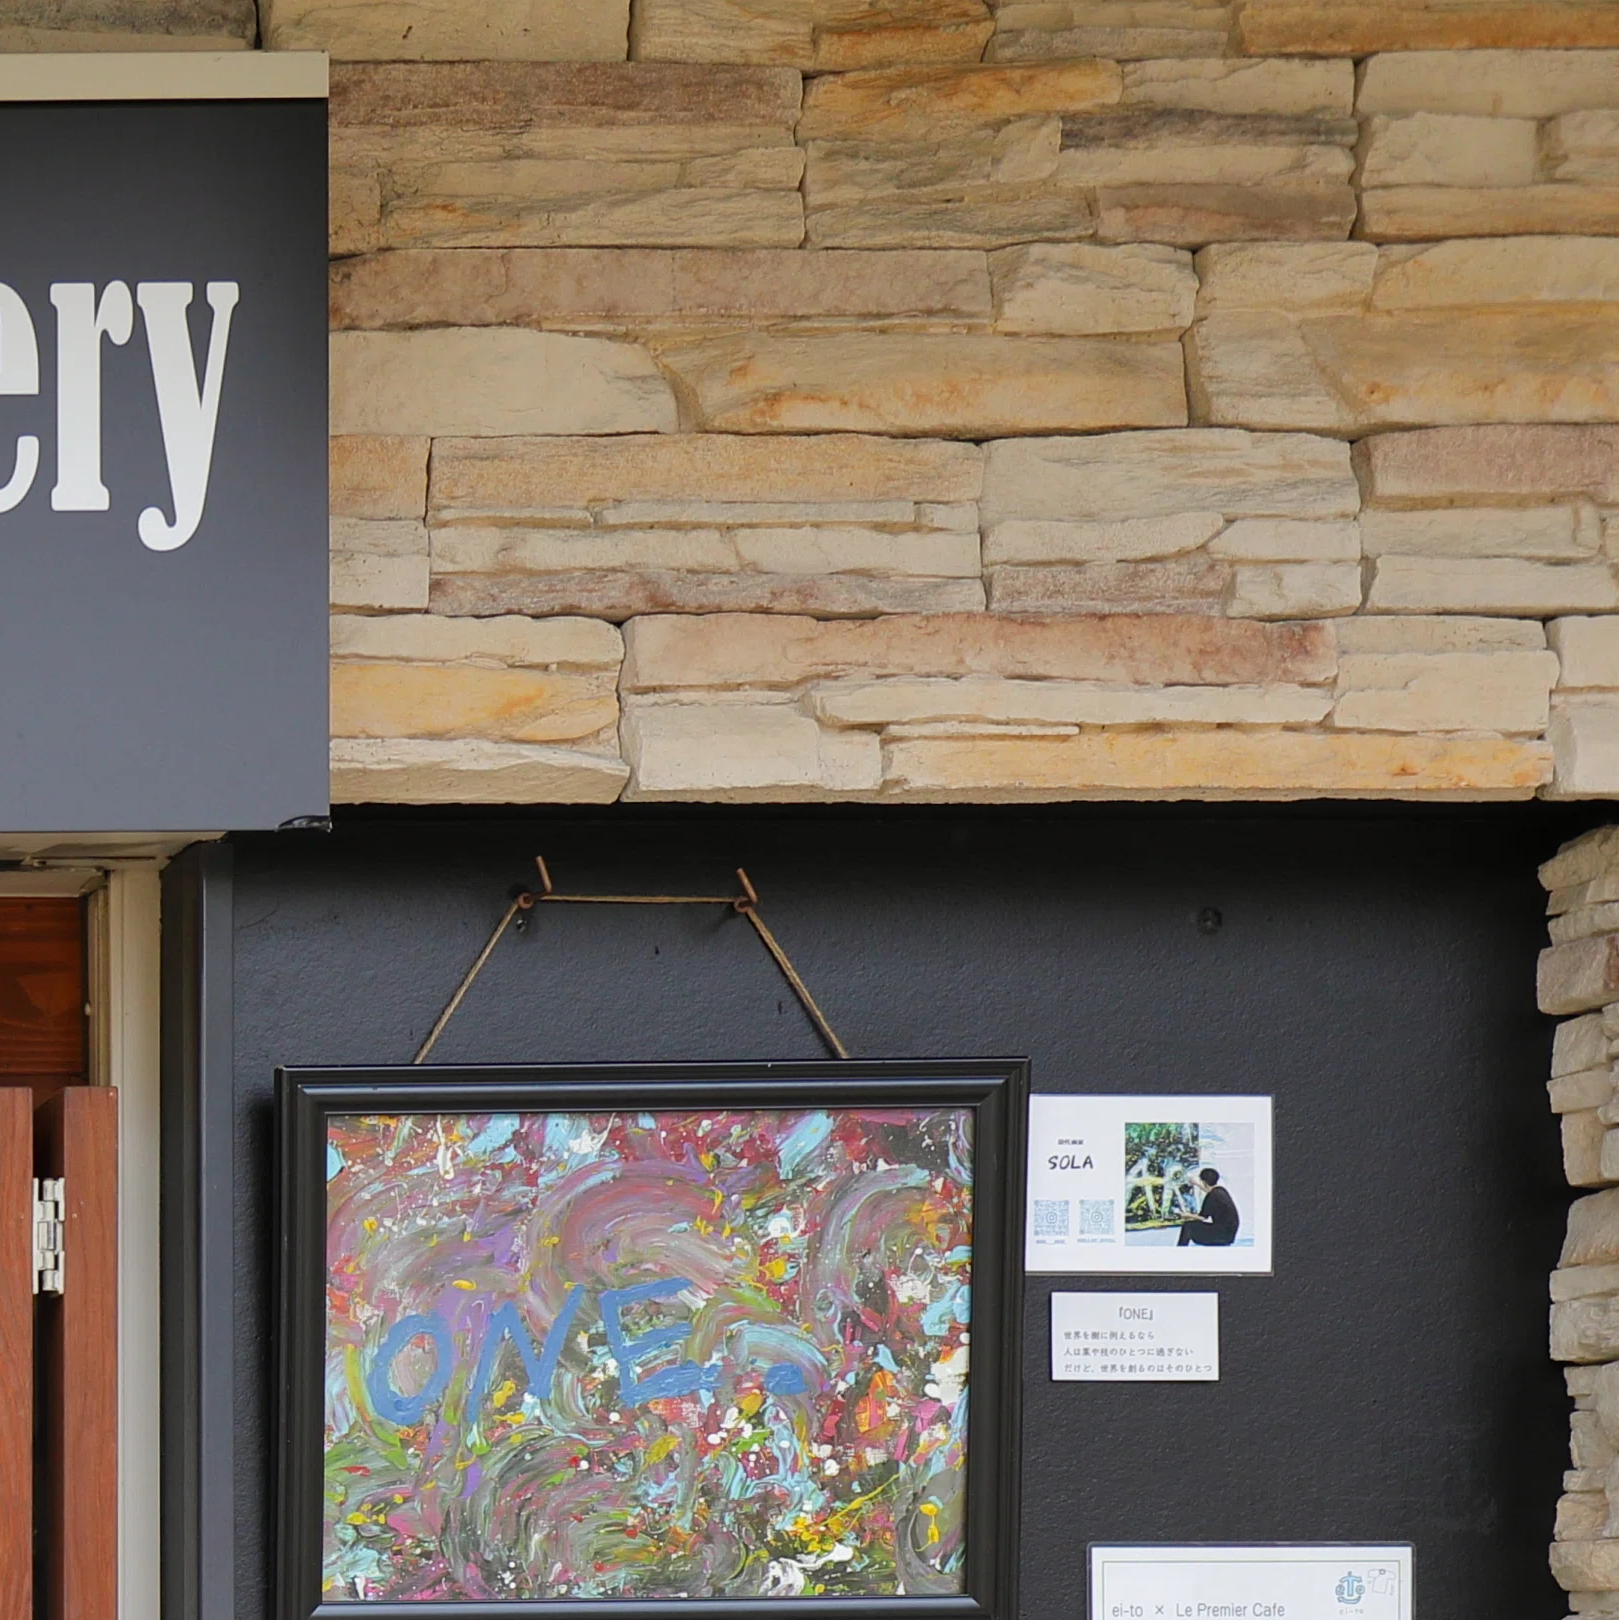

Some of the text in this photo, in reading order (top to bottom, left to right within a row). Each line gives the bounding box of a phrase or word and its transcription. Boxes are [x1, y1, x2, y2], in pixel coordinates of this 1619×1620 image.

[1048, 1154, 1094, 1171] SOLA
[1064, 1330, 1155, 1342] 世界を樹に例えるなら
[1112, 1603, 1144, 1617] ei-to
[1176, 1603, 1193, 1617] Le
[1196, 1603, 1248, 1617] Premier
[1252, 1603, 1286, 1617] Cafe
